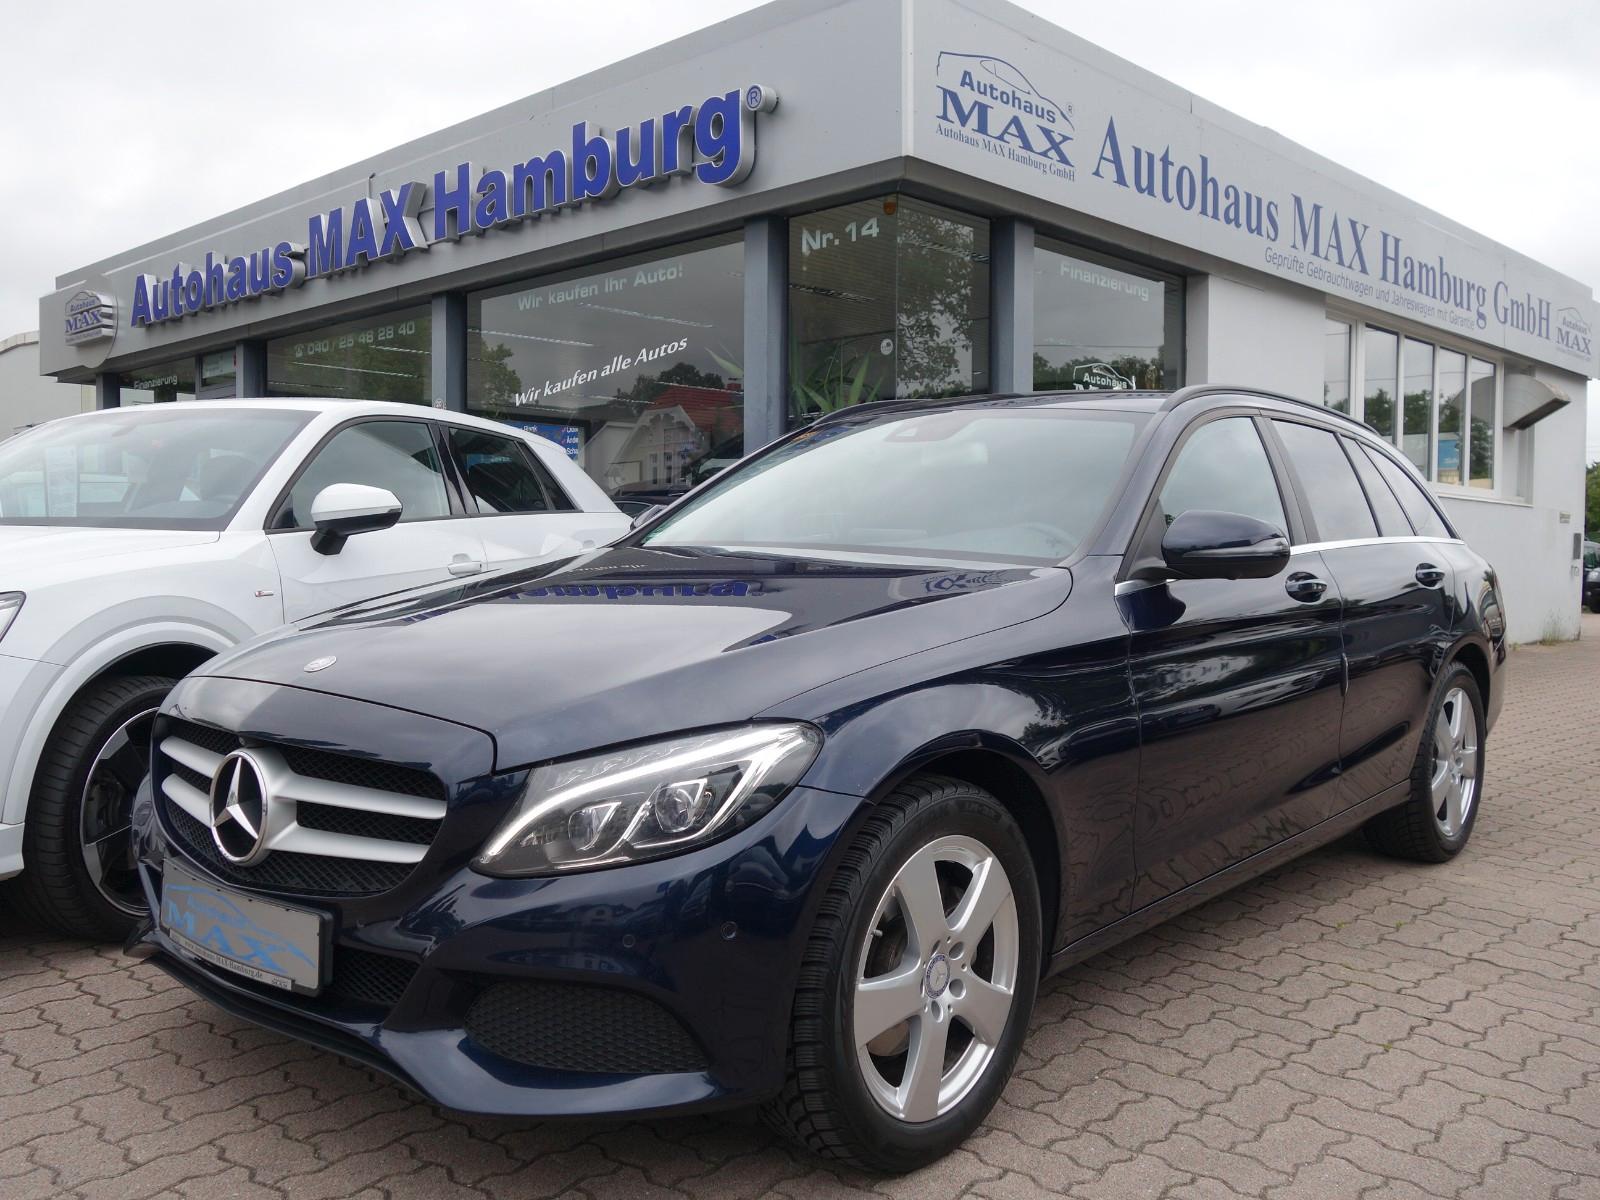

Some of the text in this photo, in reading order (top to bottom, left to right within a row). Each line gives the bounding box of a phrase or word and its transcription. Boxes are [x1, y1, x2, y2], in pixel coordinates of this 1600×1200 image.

[959, 70, 1056, 124] Autohaus
[936, 85, 1075, 167] MAX
[935, 123, 1075, 182] Autohaus MAX Hamburg GmbH
[131, 241, 296, 328] Autohaus
[308, 181, 422, 277] MAX
[433, 88, 742, 241] Hamburg
[1091, 115, 1552, 340] Autohaus MAX Hamburg GmbH
[801, 217, 880, 256] Nr. 14
[517, 263, 684, 312] Wir kaufen Ihr Auto!
[1060, 261, 1151, 302] Finanzierung
[1264, 246, 1305, 274] Geprüfte
[1306, 261, 1374, 298] Gebrauchtwagen
[1375, 286, 1390, 303] und
[65, 309, 102, 333] MAX
[377, 325, 395, 341] 28
[397, 320, 416, 336] 40
[1556, 326, 1592, 356] MAX
[133, 374, 178, 391] Finanzierung
[514, 336, 688, 408] Wir kaufen alle Autos
[1083, 372, 1128, 389] Autohaus
[163, 897, 290, 975] MAX
